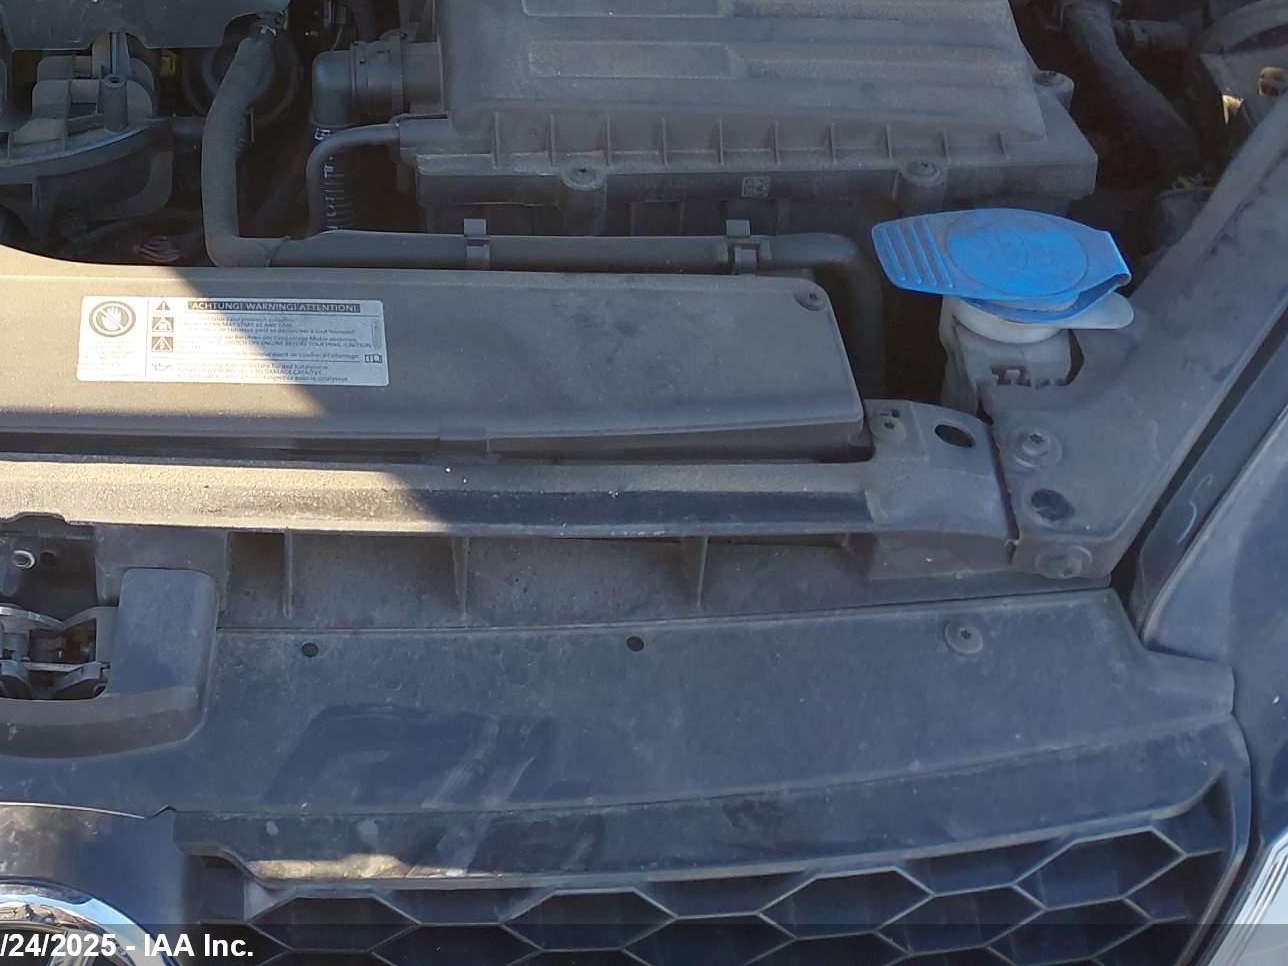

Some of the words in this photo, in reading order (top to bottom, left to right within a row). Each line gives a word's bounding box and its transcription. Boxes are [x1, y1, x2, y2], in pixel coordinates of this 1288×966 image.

[192, 300, 243, 311] ACHTUNG!
[245, 302, 297, 312] WARNING!
[299, 303, 357, 313] ATTENTION!
